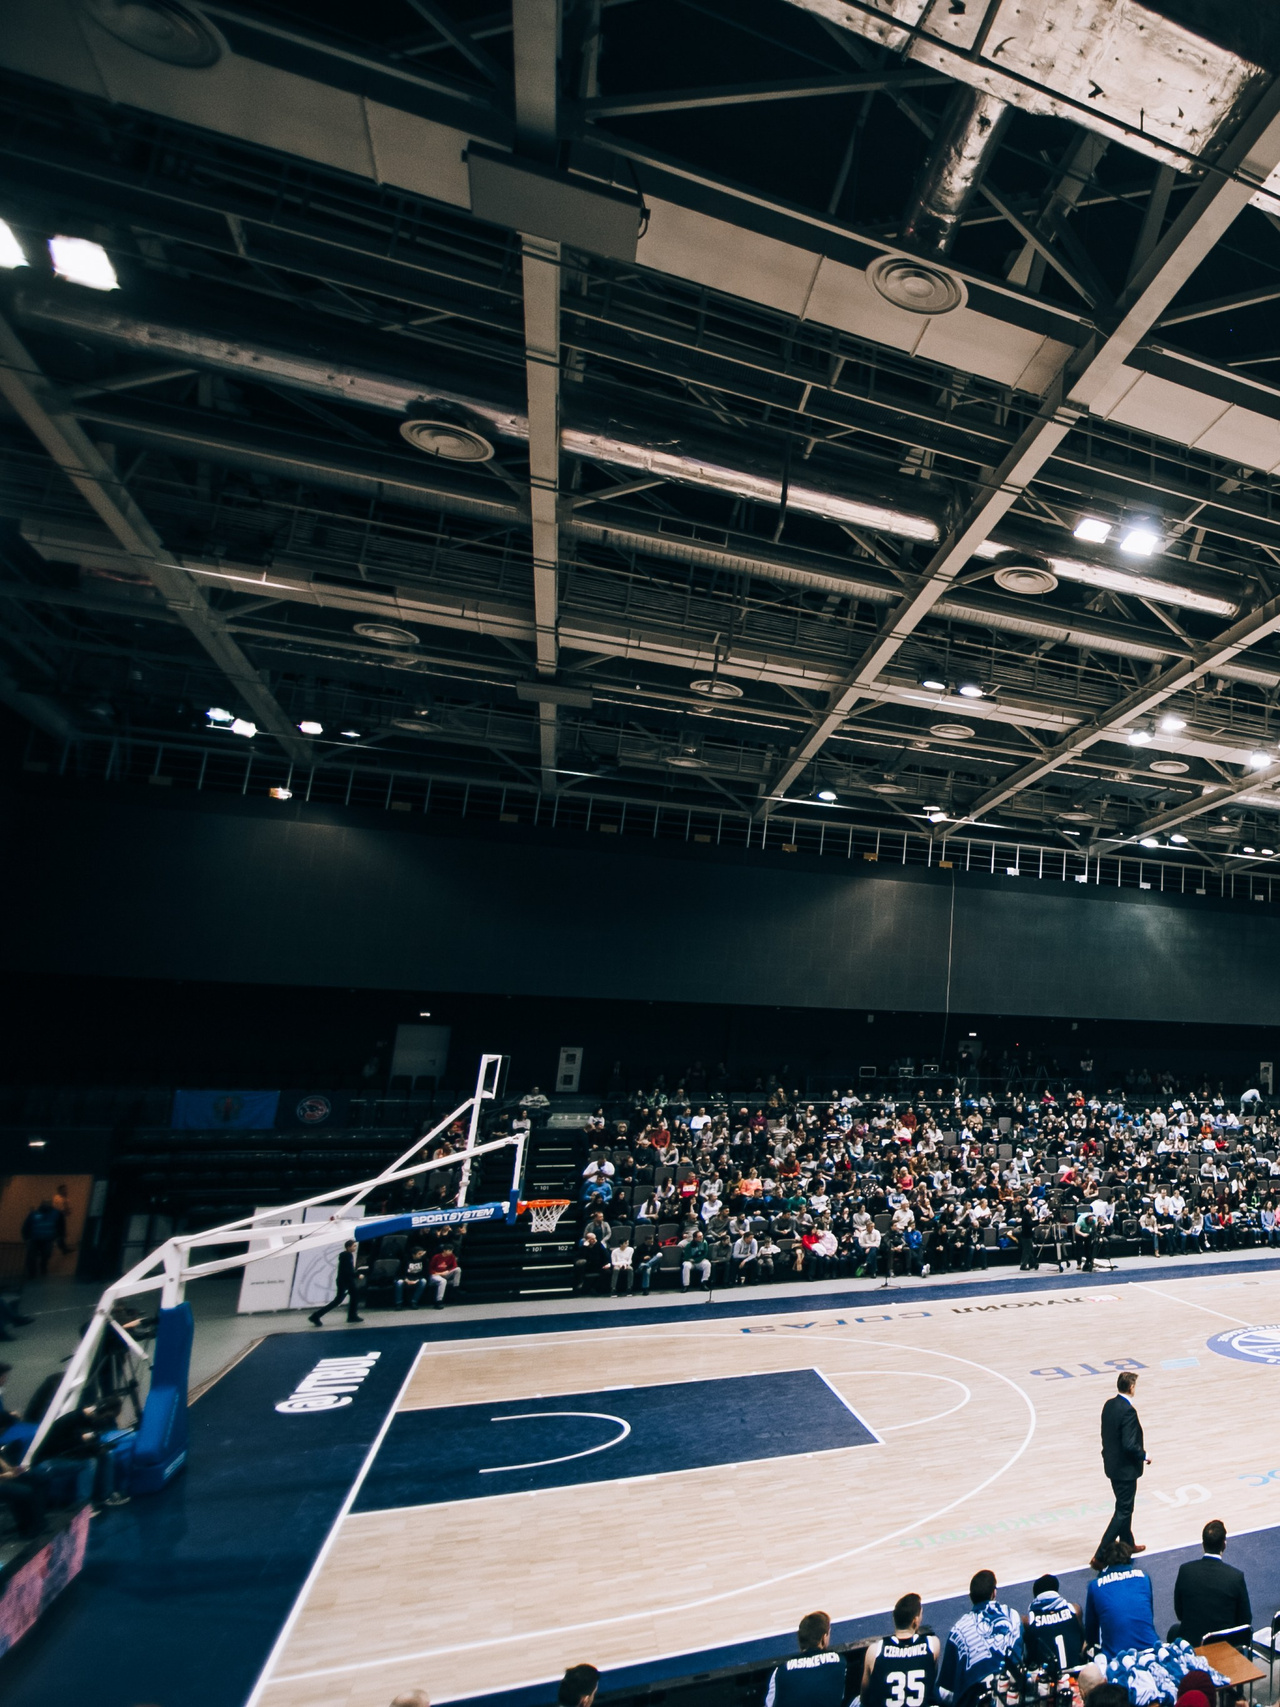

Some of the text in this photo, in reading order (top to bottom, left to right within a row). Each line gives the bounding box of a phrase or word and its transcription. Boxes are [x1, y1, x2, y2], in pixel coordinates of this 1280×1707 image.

[1029, 1358, 1149, 1381] ВТБ
[1035, 1608, 1072, 1627] SADDLER
[884, 1643, 927, 1658] CZERAPOWICZ
[1055, 1634, 1067, 1669] 1
[886, 1669, 926, 1707] 35
